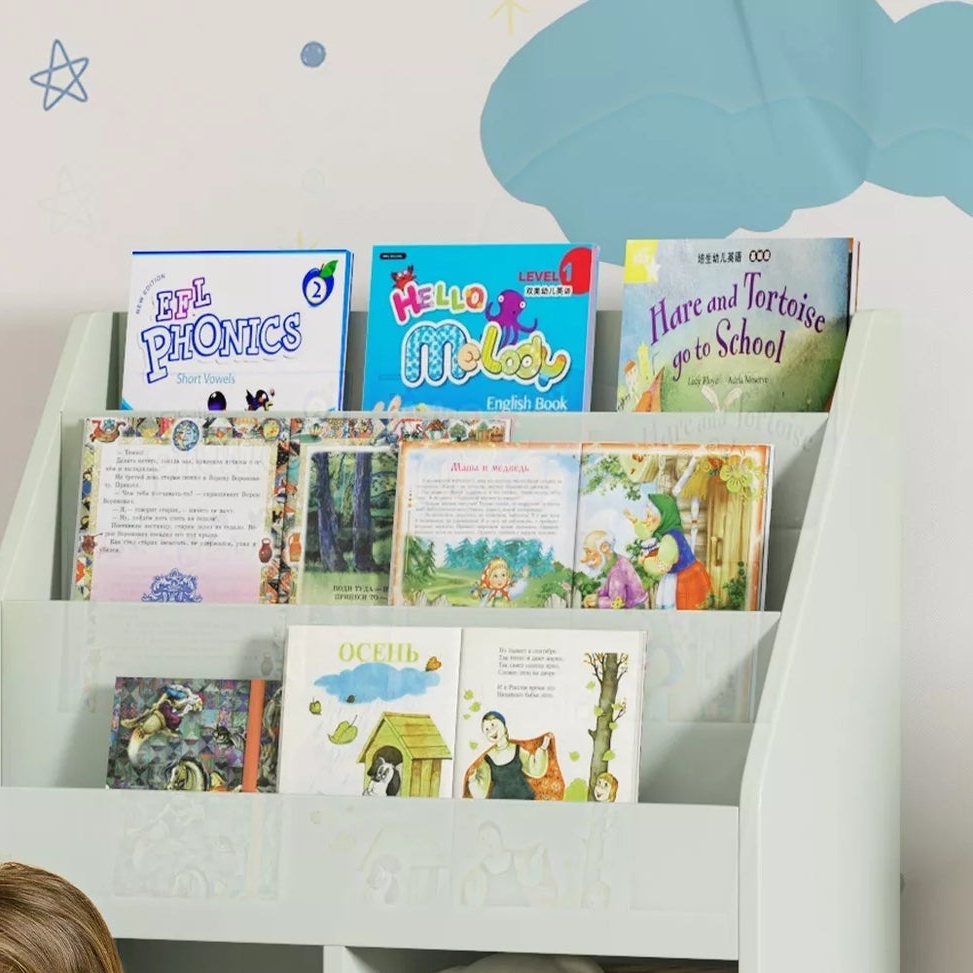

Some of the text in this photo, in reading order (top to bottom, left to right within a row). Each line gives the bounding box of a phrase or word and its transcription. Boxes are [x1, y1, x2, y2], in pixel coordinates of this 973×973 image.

[518, 271, 559, 282] LEVEL
[155, 276, 212, 323] EFL
[311, 281, 322, 299] 2
[391, 281, 486, 322] HELLO
[648, 271, 826, 346] Hare and Tortoise
[141, 312, 302, 384] PHONICS
[672, 317, 787, 382] go to School
[176, 372, 236, 385] Short Vowels
[486, 395, 568, 411] English Book
[492, 464, 530, 473] медведь
[337, 641, 420, 663] ОСЕНЬ
